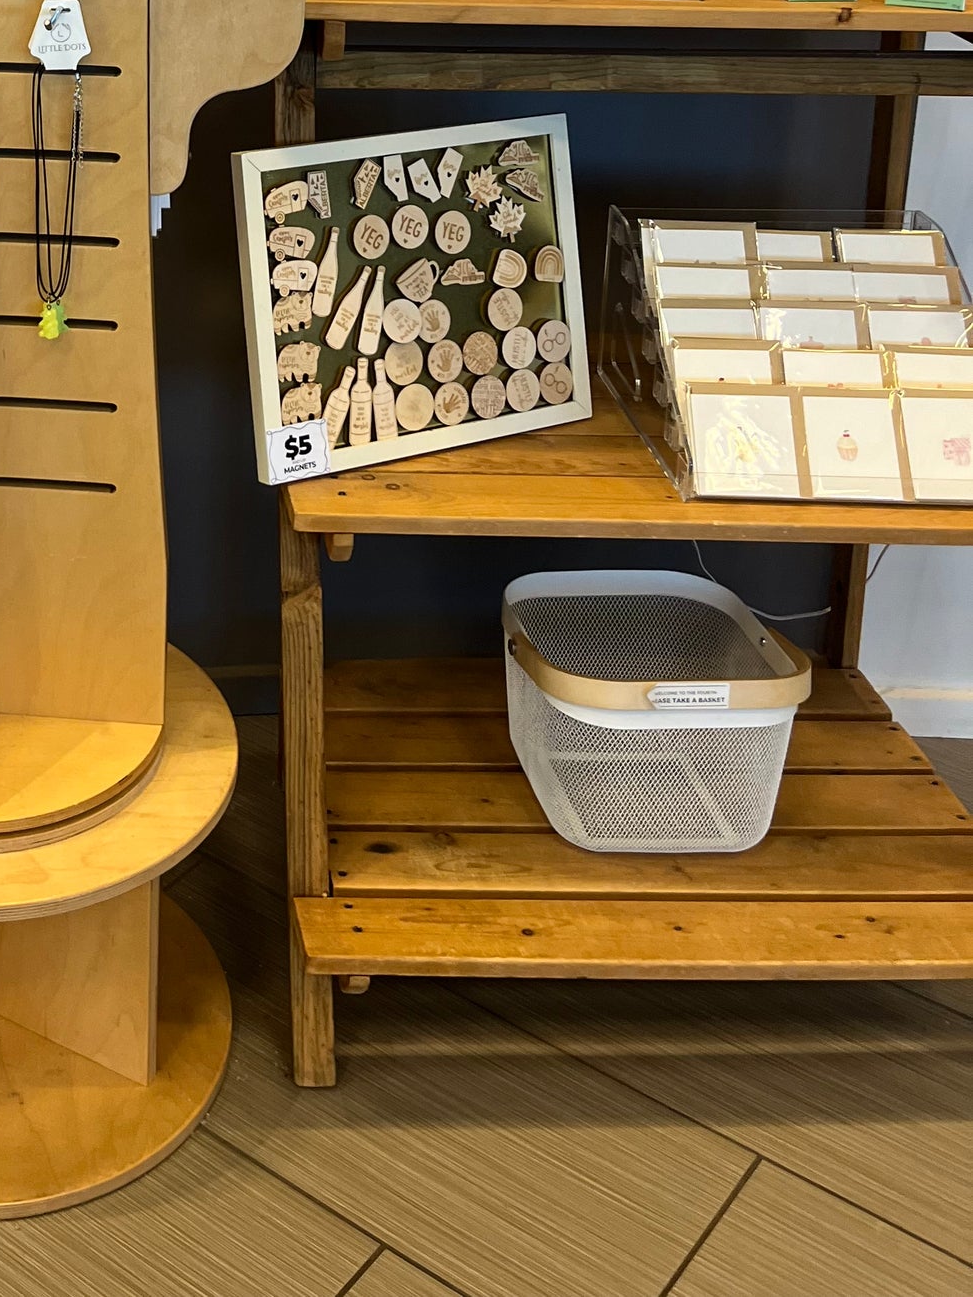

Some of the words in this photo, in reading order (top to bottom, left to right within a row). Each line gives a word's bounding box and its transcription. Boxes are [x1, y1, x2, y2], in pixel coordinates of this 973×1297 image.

[38, 44, 62, 54] LITTLE
[64, 43, 86, 51] DOTS
[360, 223, 384, 250] YEG
[399, 214, 423, 238] YEG
[442, 221, 465, 242] YEG
[284, 434, 312, 460] $5
[284, 461, 317, 474] MAGNETS
